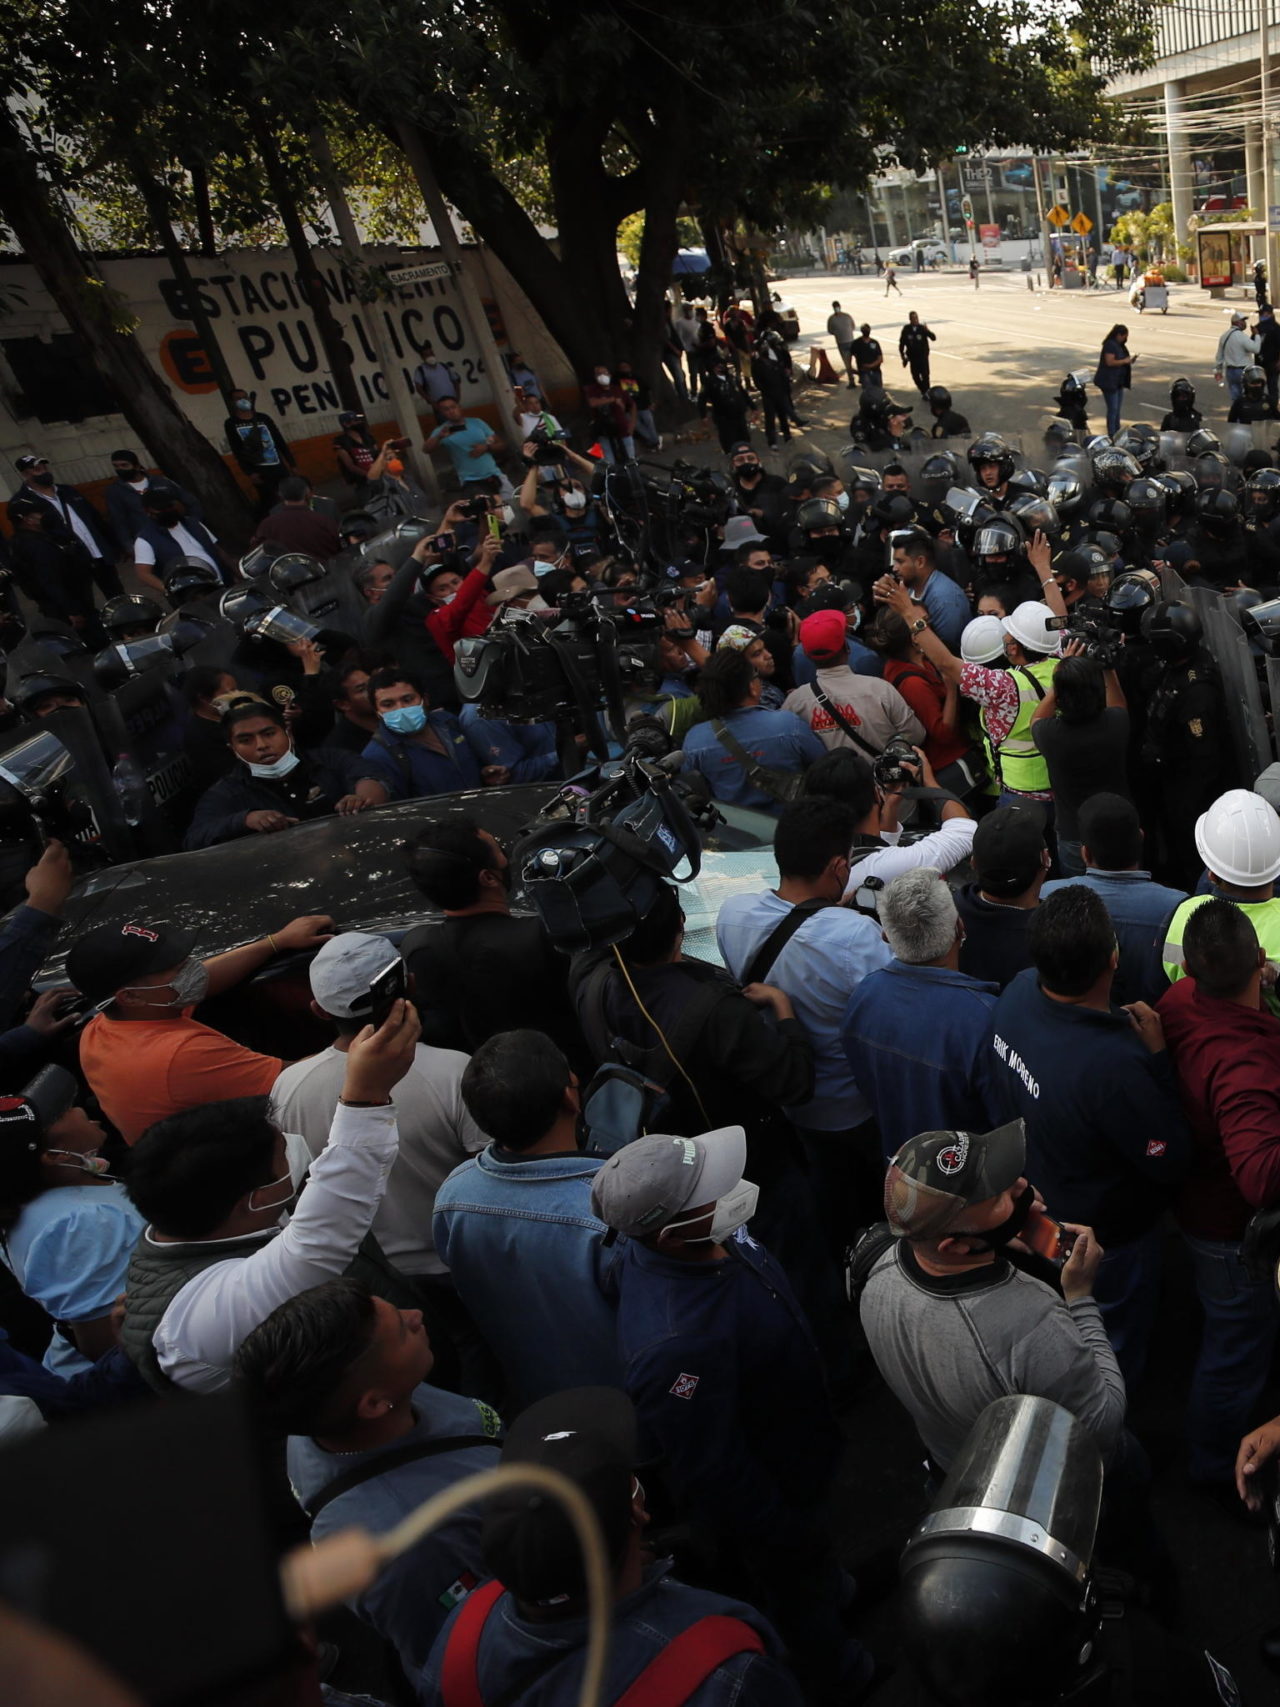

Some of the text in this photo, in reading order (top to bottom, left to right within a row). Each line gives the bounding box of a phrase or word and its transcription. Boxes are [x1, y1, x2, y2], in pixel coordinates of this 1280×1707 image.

[391, 265, 449, 284] SACRAMENTO
[238, 305, 465, 380] PULICO
[994, 1034, 1040, 1099] ERIK MORENO
